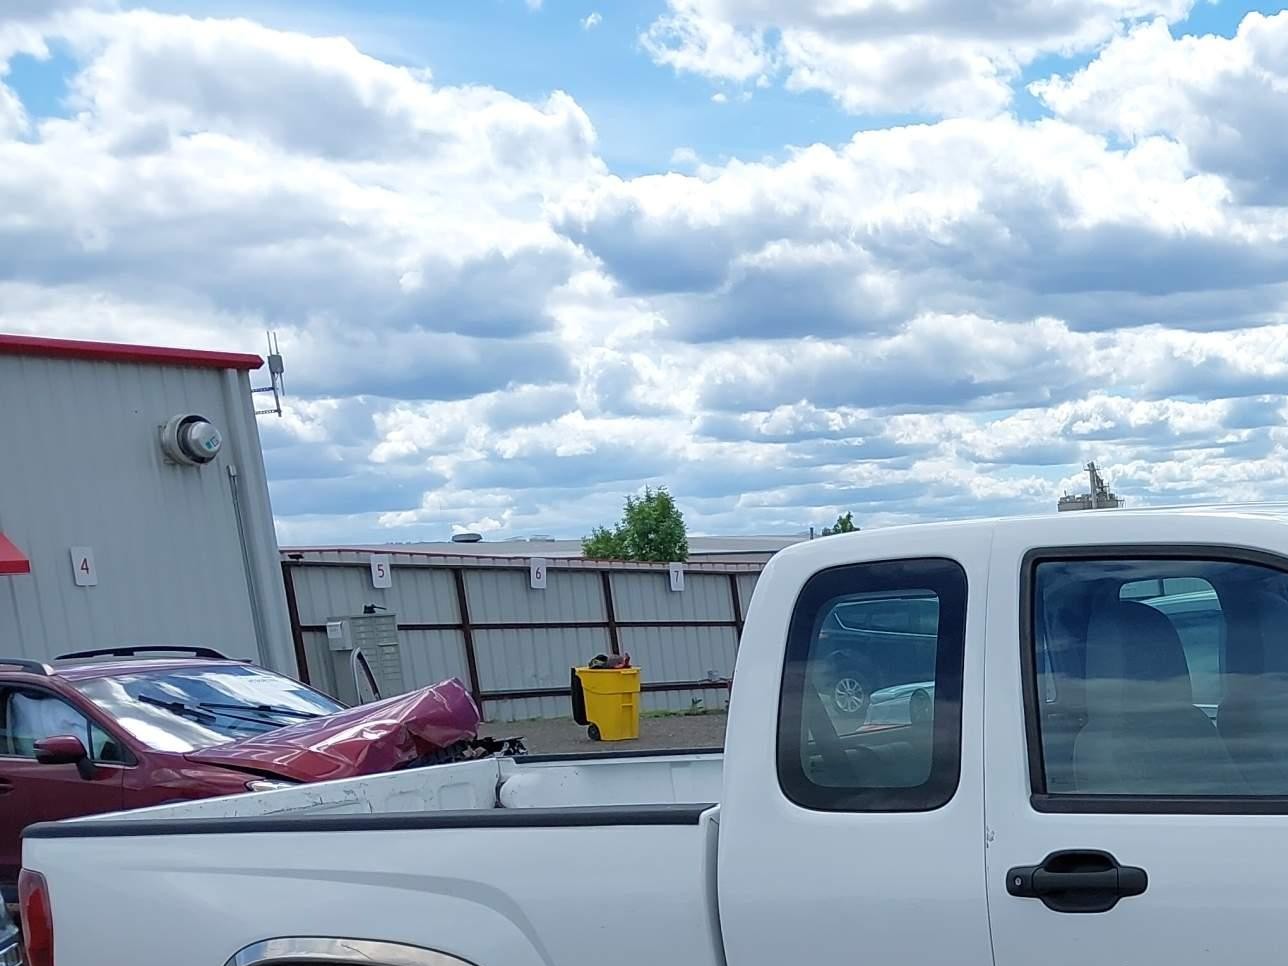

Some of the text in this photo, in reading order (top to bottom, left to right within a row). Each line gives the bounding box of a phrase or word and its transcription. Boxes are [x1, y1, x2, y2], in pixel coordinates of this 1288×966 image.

[80, 558, 90, 575] 4
[377, 563, 385, 578] 5
[535, 567, 542, 580] 6
[674, 570, 680, 583] 7
